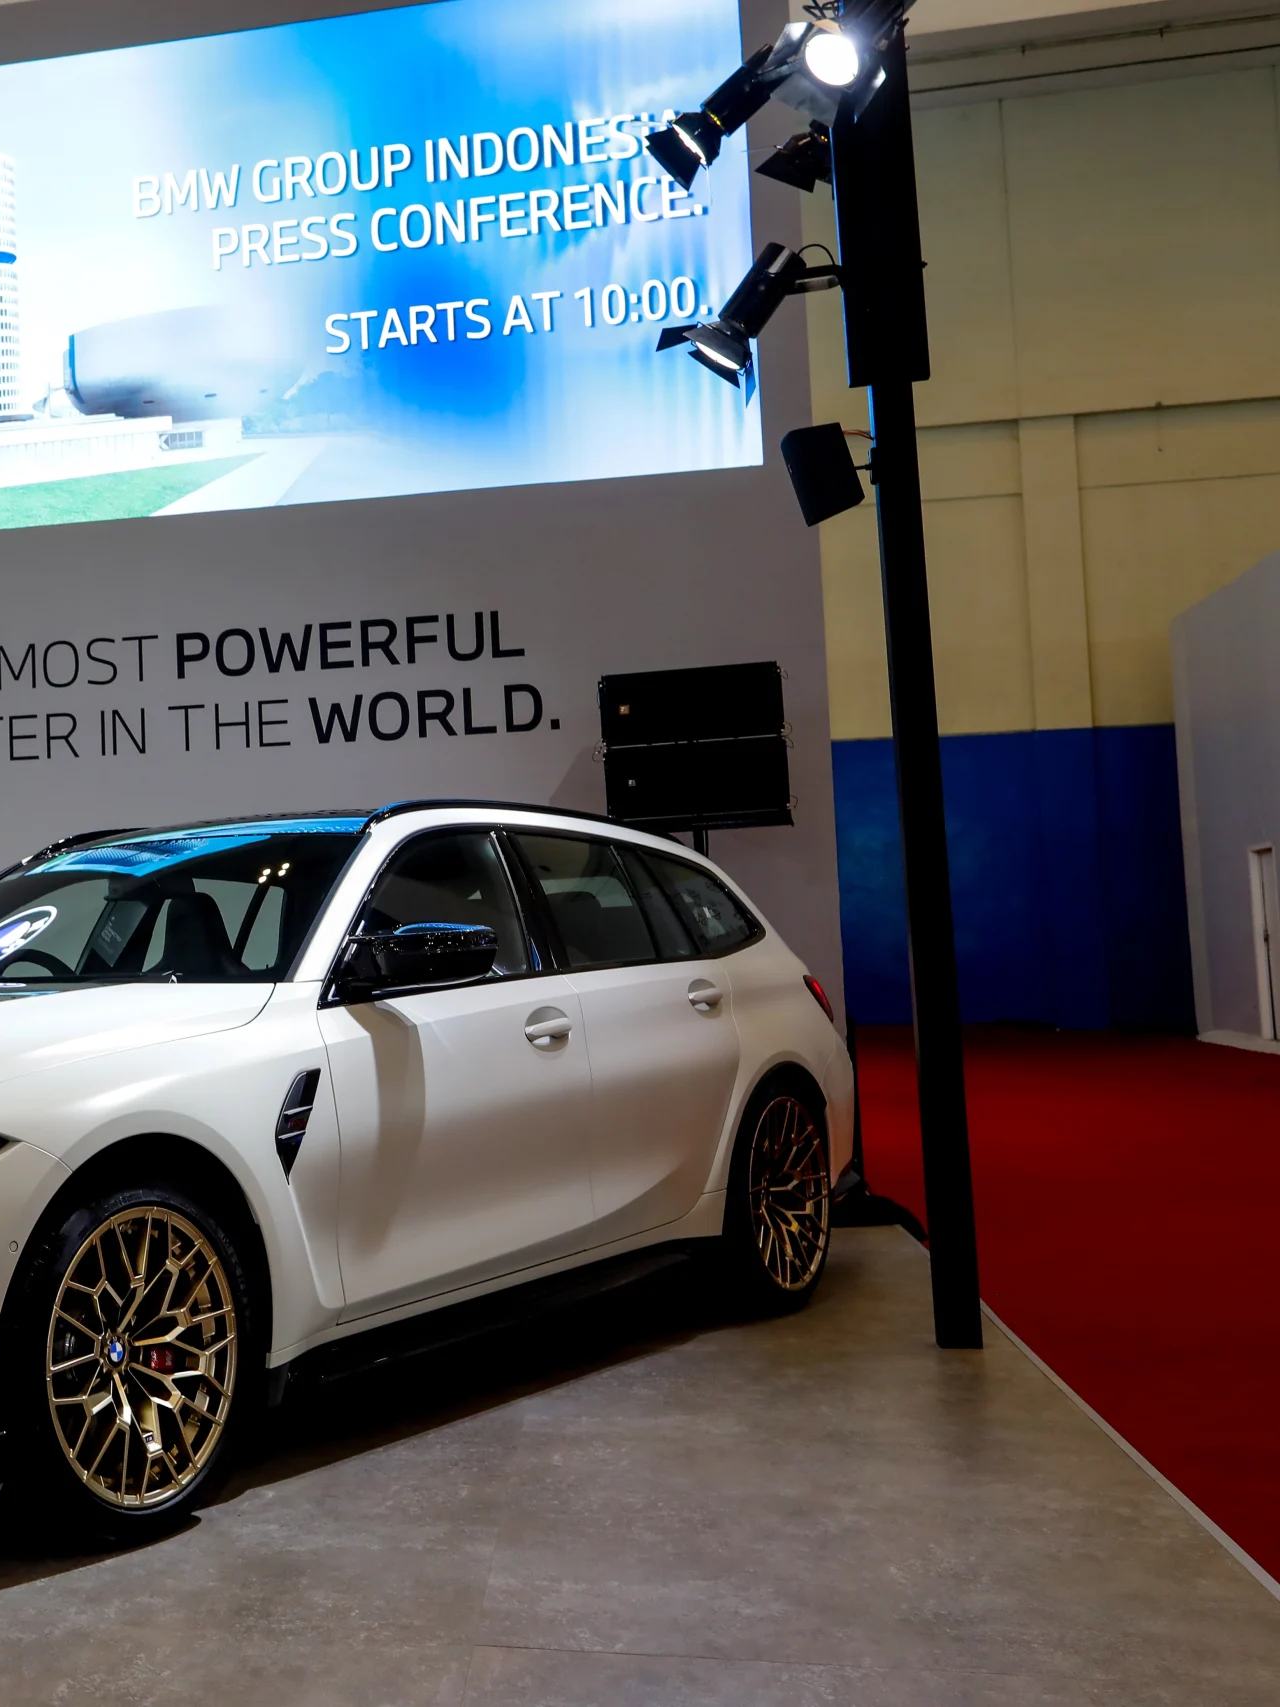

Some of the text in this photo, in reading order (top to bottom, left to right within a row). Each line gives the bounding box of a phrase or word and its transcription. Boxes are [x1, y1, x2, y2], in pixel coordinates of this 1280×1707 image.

[132, 108, 679, 218] BMW GROUP INDONESI
[212, 174, 703, 271] PRESS CONFERENCE.
[325, 275, 709, 354] STARTS AT 10:00.
[176, 610, 525, 680] POWERFUL
[100, 707, 147, 757] IN
[168, 698, 291, 752] THE
[308, 683, 561, 745] WORLD.
